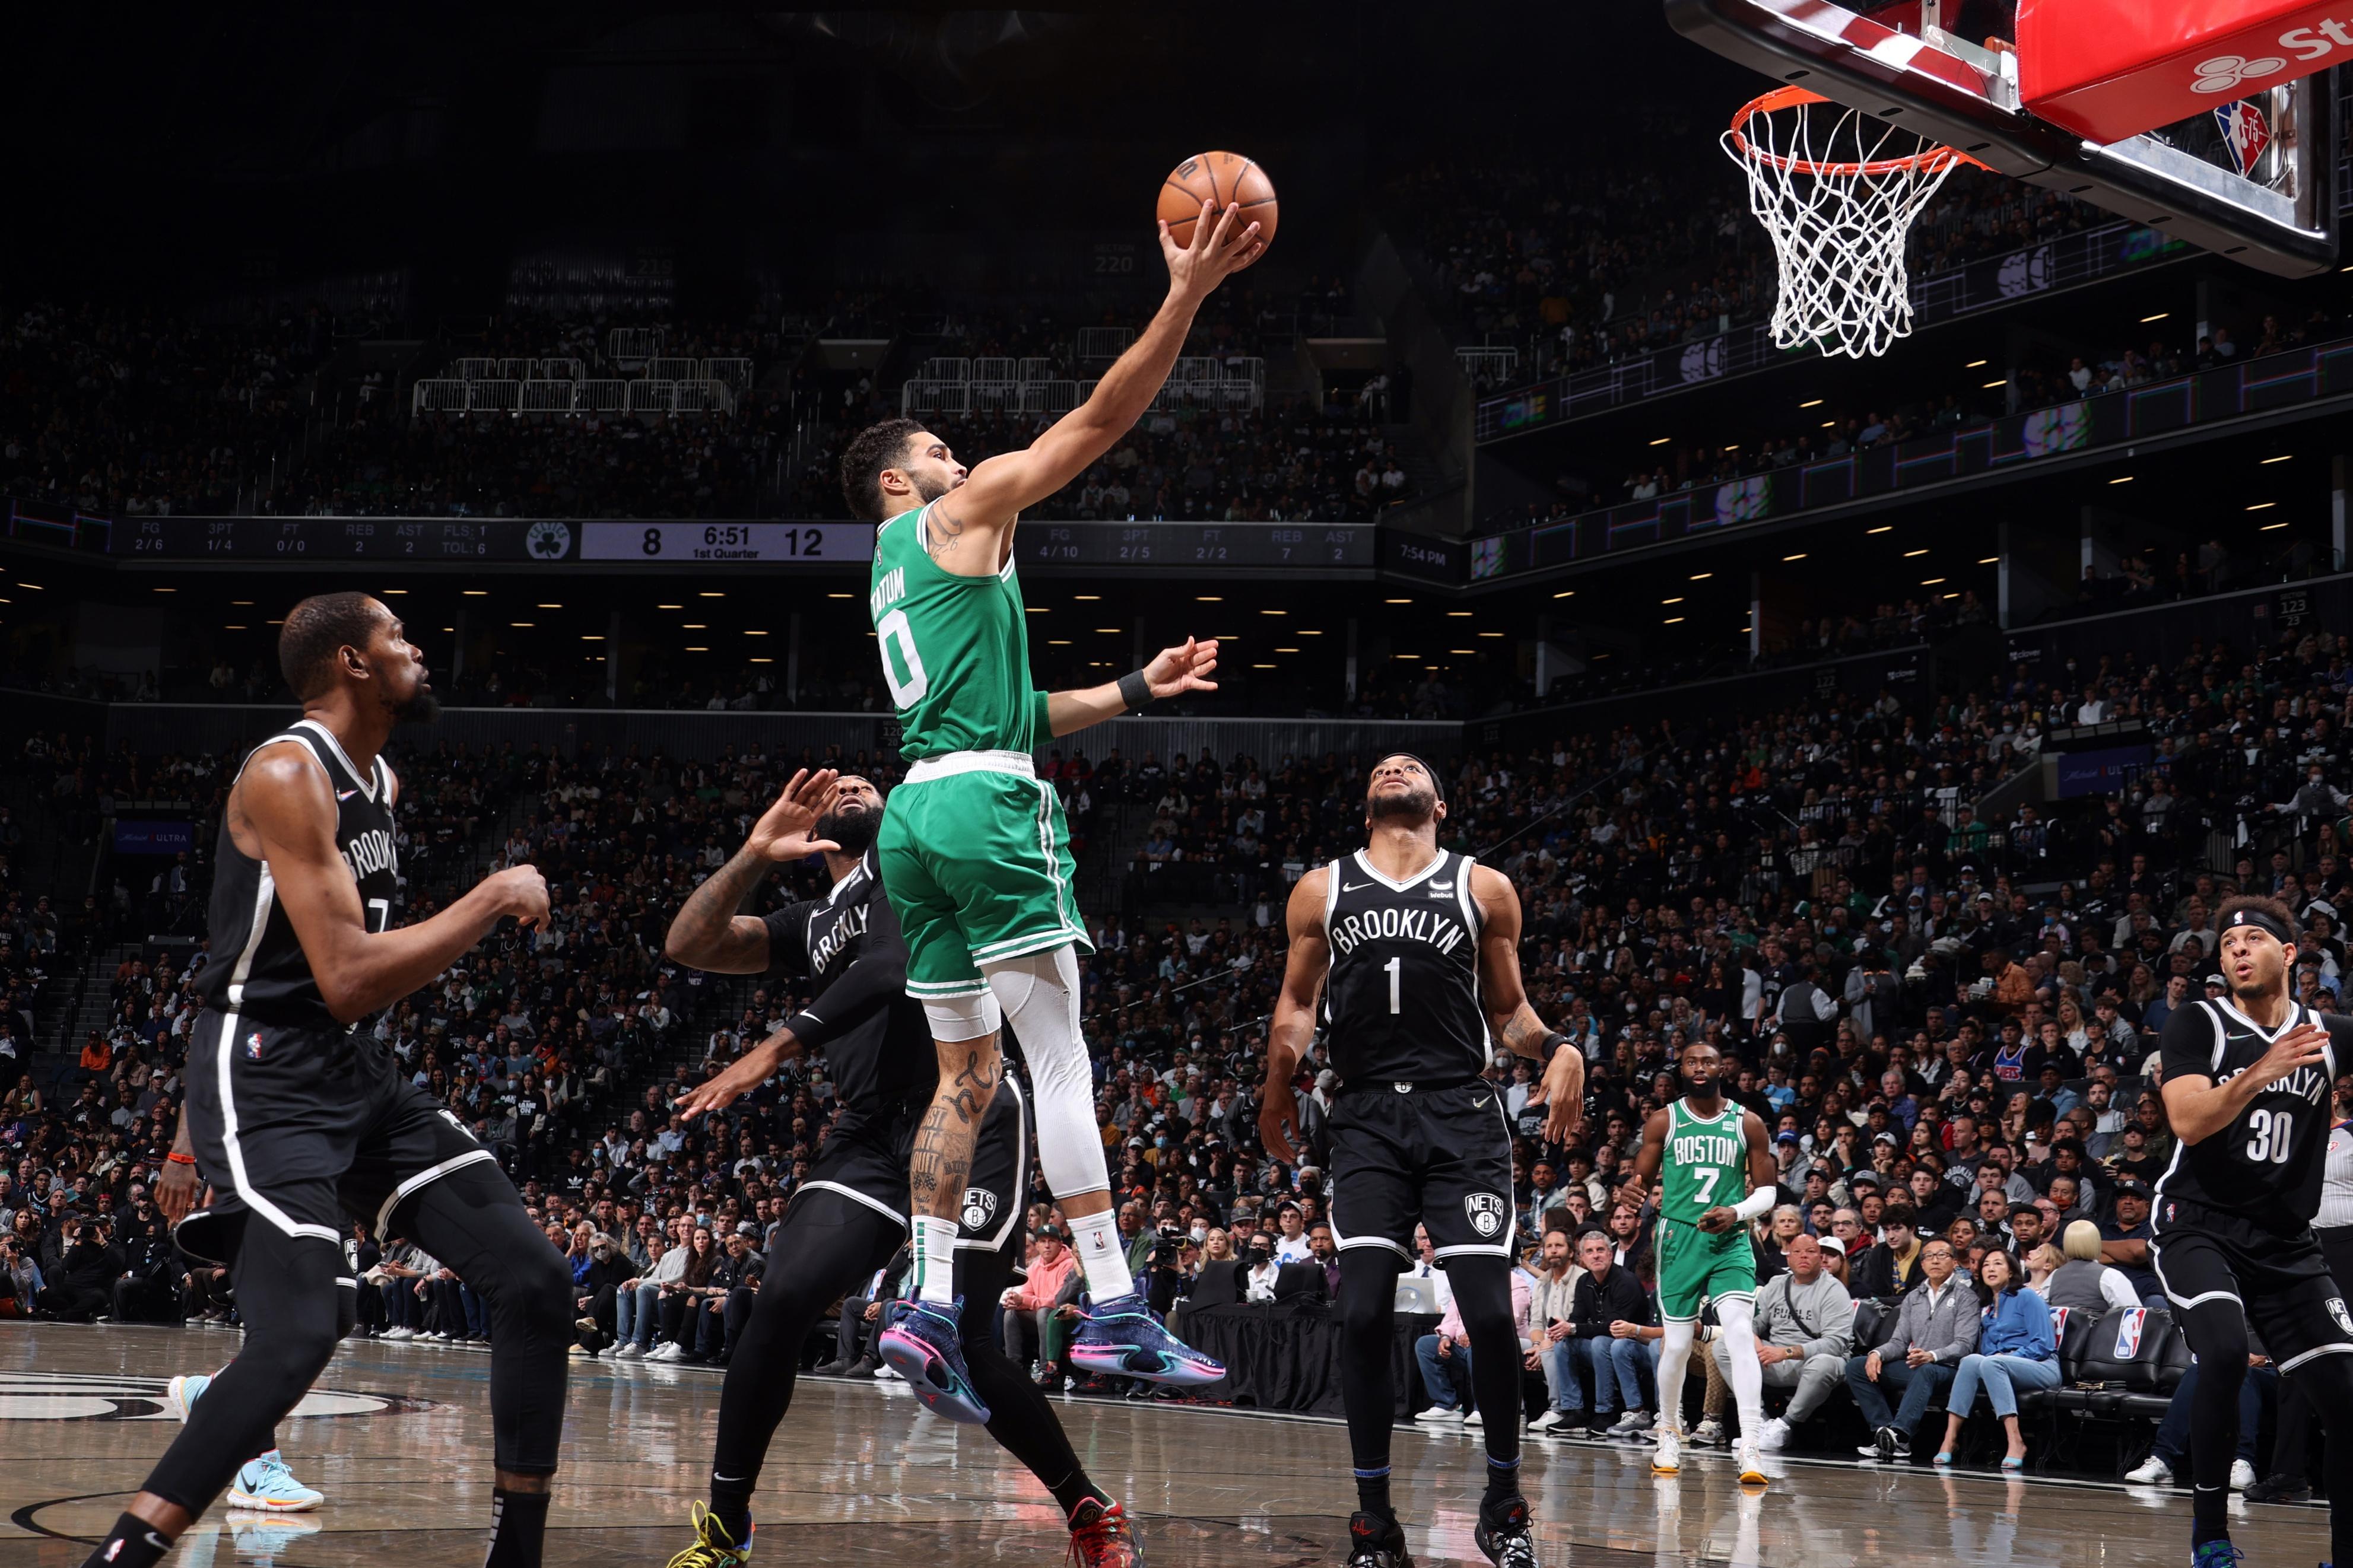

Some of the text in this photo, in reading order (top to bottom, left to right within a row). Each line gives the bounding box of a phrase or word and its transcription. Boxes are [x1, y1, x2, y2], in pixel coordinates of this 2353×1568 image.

[2278, 18, 2353, 61] St
[2247, 116, 2259, 142] 75
[1094, 256, 1133, 273] 220
[141, 522, 160, 533] FG
[208, 523, 234, 534] 3PT
[282, 523, 300, 535] FT
[345, 524, 374, 536] REB
[396, 524, 424, 536] AST
[479, 525, 485, 536] 1
[1050, 529, 1070, 540] FG
[643, 529, 661, 555] 8
[704, 527, 749, 545] 6:51
[785, 529, 823, 556] 12
[1123, 530, 1149, 541] 3PT
[1204, 530, 1222, 541] FT
[1272, 530, 1303, 543] REB
[1325, 530, 1355, 543] AST
[355, 541, 364, 553] 2
[405, 542, 414, 554] 2
[477, 543, 485, 554] 6
[693, 548, 759, 559] 1st Quarter
[1282, 548, 1291, 560] 7
[1333, 548, 1343, 560] 2
[1400, 544, 1446, 566] 7:54 PM
[871, 566, 906, 623] TATUM
[2280, 599, 2306, 614] 123
[2287, 616, 2301, 626] 23
[878, 608, 928, 711] 0
[883, 727, 903, 736] 120
[368, 898, 389, 933] 7
[1332, 908, 1466, 956] BROOKLYN
[1383, 956, 1401, 1015] 1
[2246, 1108, 2293, 1164] 30
[1674, 1135, 1738, 1168] BOSTON
[1693, 1167, 1720, 1204] 7
[1468, 1195, 1502, 1216] NETS
[972, 1208, 979, 1224] B
[1484, 1214, 1490, 1230] B
